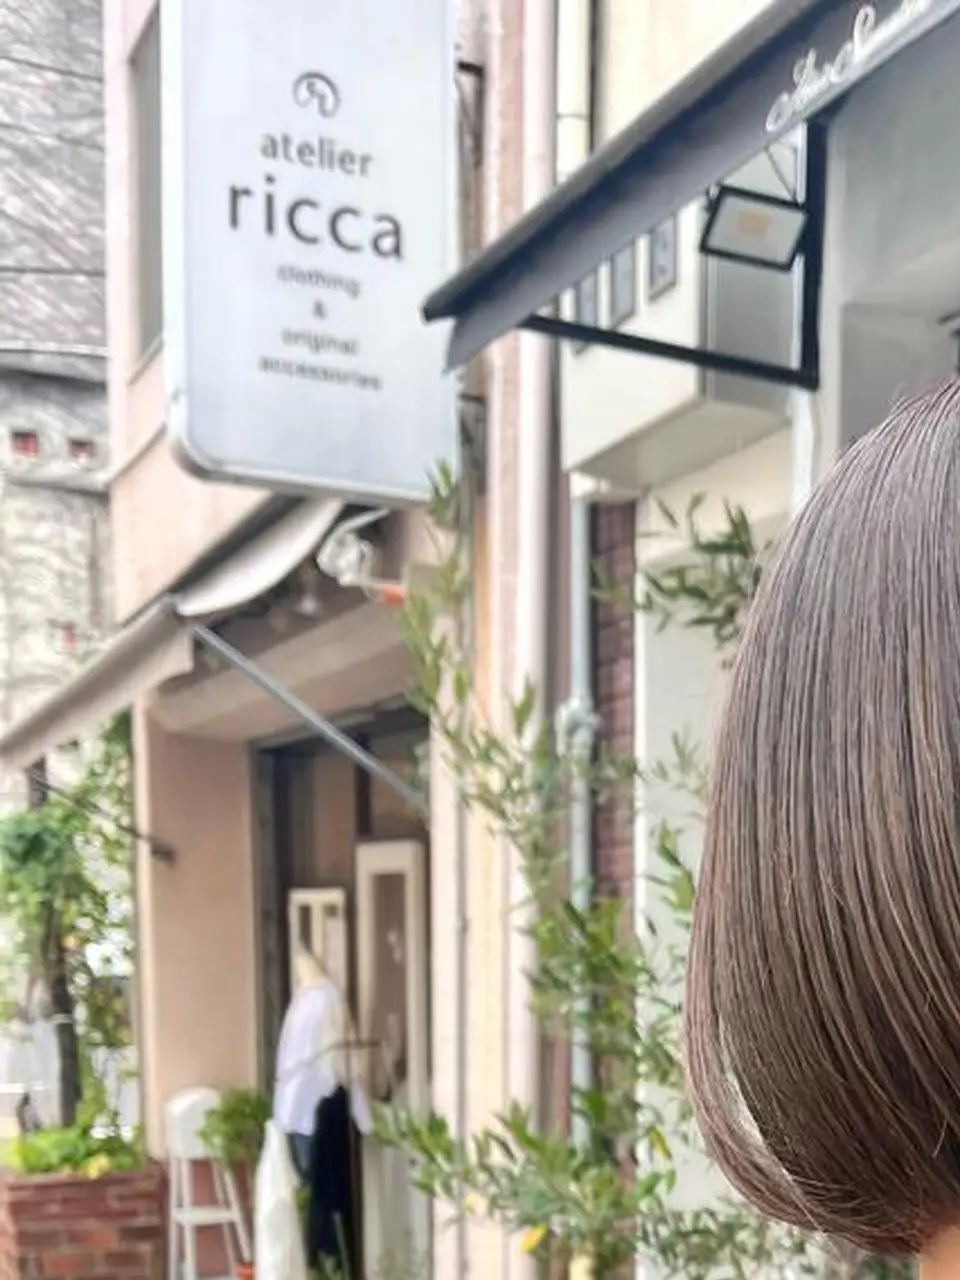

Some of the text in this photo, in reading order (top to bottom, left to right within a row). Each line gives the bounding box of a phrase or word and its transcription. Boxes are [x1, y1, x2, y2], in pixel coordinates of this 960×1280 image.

[260, 133, 373, 175] atelier
[229, 174, 404, 262] ricca
[277, 264, 361, 299] clothing
